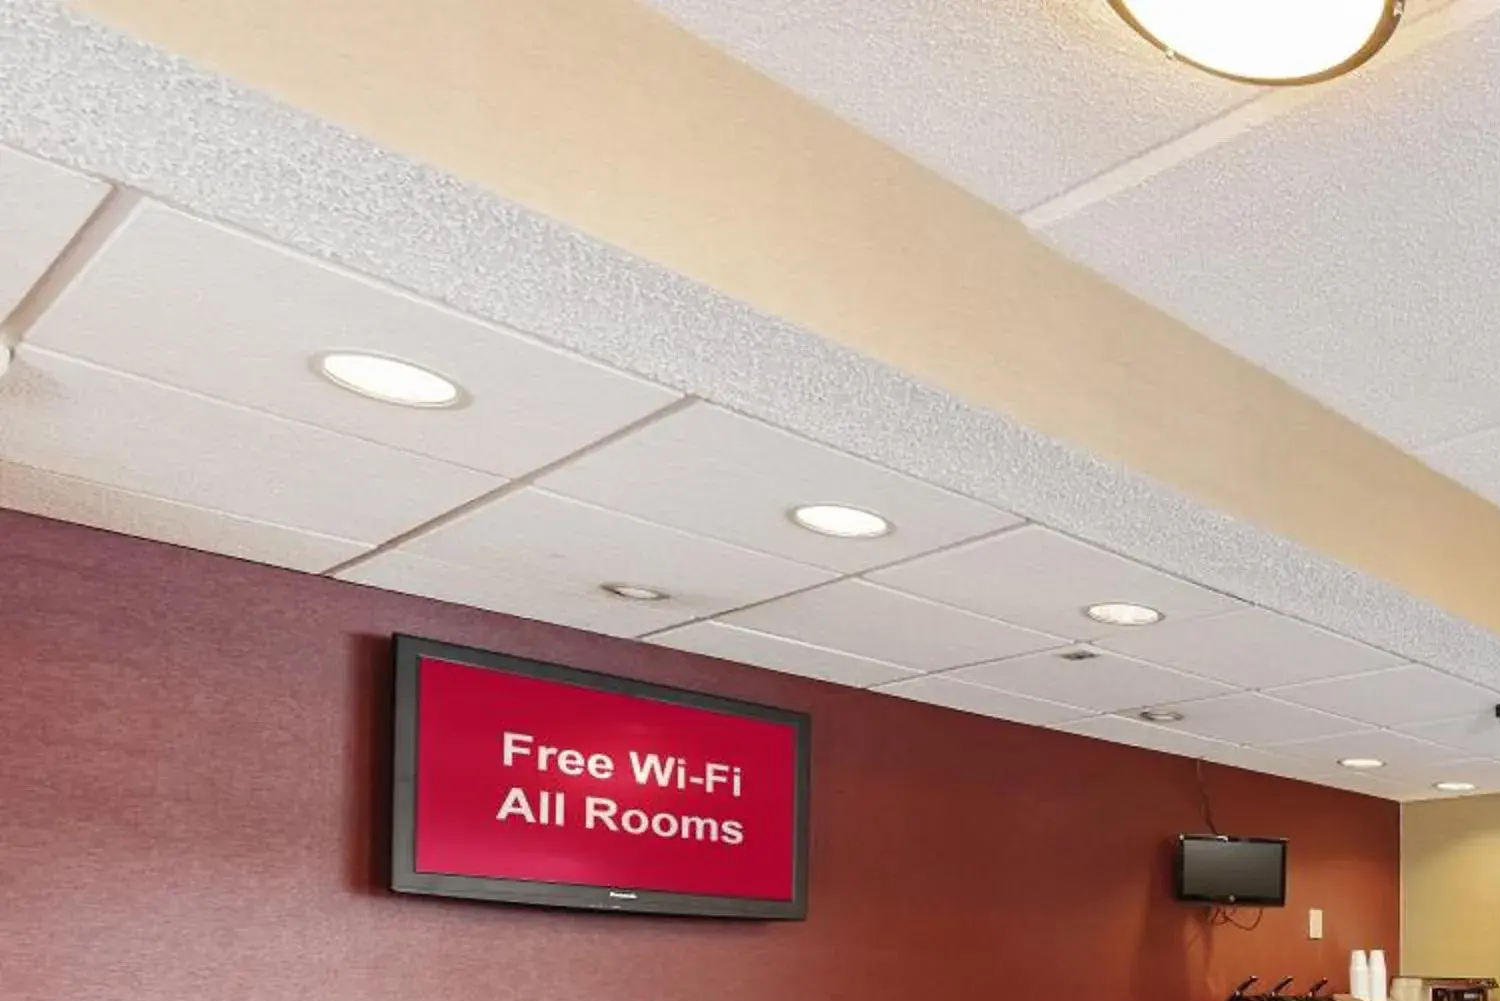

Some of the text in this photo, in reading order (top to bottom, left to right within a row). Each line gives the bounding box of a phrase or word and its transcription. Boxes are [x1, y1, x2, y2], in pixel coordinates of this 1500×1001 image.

[502, 731, 742, 797] Free Wi-Fi
[495, 787, 744, 845] All Rooms
